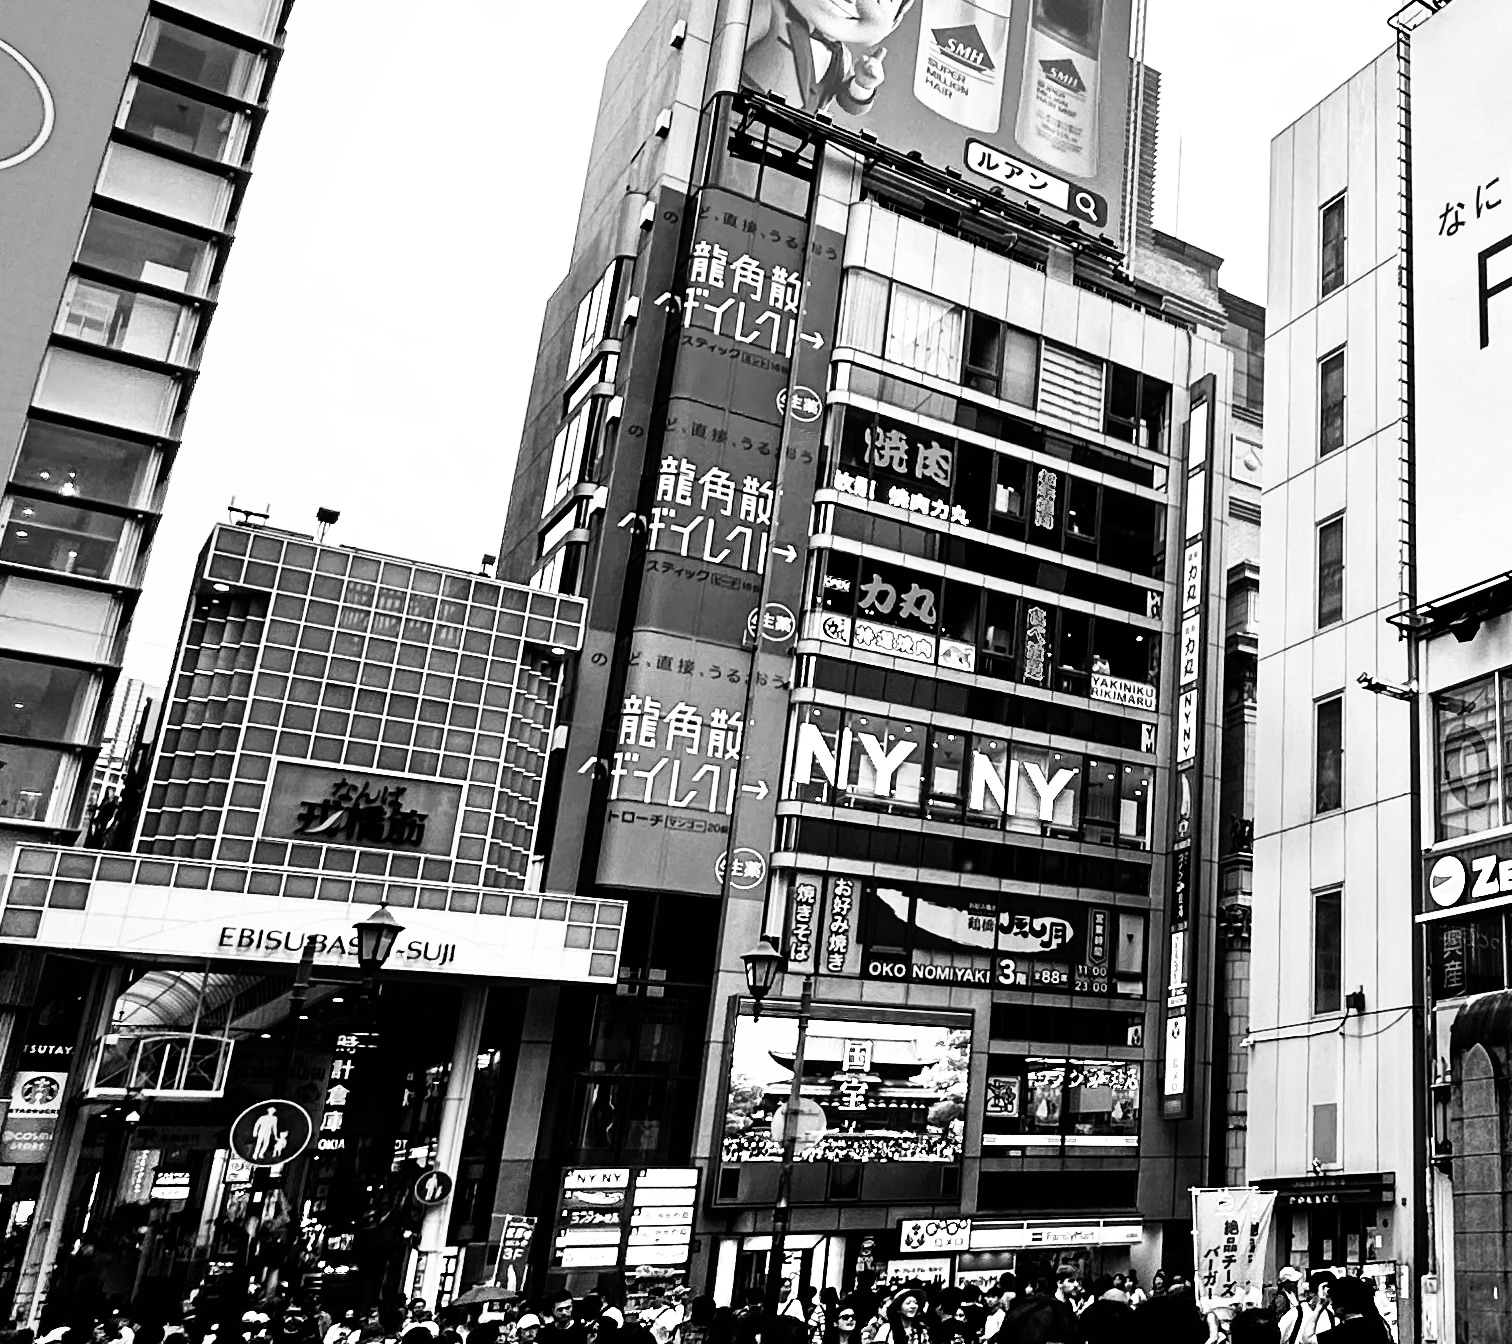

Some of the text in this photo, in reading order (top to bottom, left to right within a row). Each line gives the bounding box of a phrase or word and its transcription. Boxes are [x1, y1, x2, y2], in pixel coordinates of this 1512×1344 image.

[947, 39, 984, 65] SMH
[1050, 67, 1078, 87] SMH
[977, 152, 1048, 190] ルアン
[690, 240, 811, 314] 龍角散
[864, 426, 952, 487] 焼肉
[657, 455, 785, 525] 龍角散
[858, 574, 937, 625] 力丸
[1091, 687, 1153, 708] RIKIMARU
[1092, 675, 1154, 698] YAKINIKU
[619, 695, 756, 760] 龍角散
[332, 778, 408, 809] なんば
[795, 724, 1080, 831] NY NY
[608, 810, 664, 827] トローチ
[790, 883, 816, 963] 焼きそば
[827, 877, 853, 973] お好み焼き
[218, 927, 457, 964] EBISUBAS-SUJI
[868, 962, 992, 984] OKO NOMIYAKI
[23, 1044, 74, 1055] TSUTAY
[503, 1248, 525, 1260] 3F
[1203, 1245, 1221, 1300] バーガー
